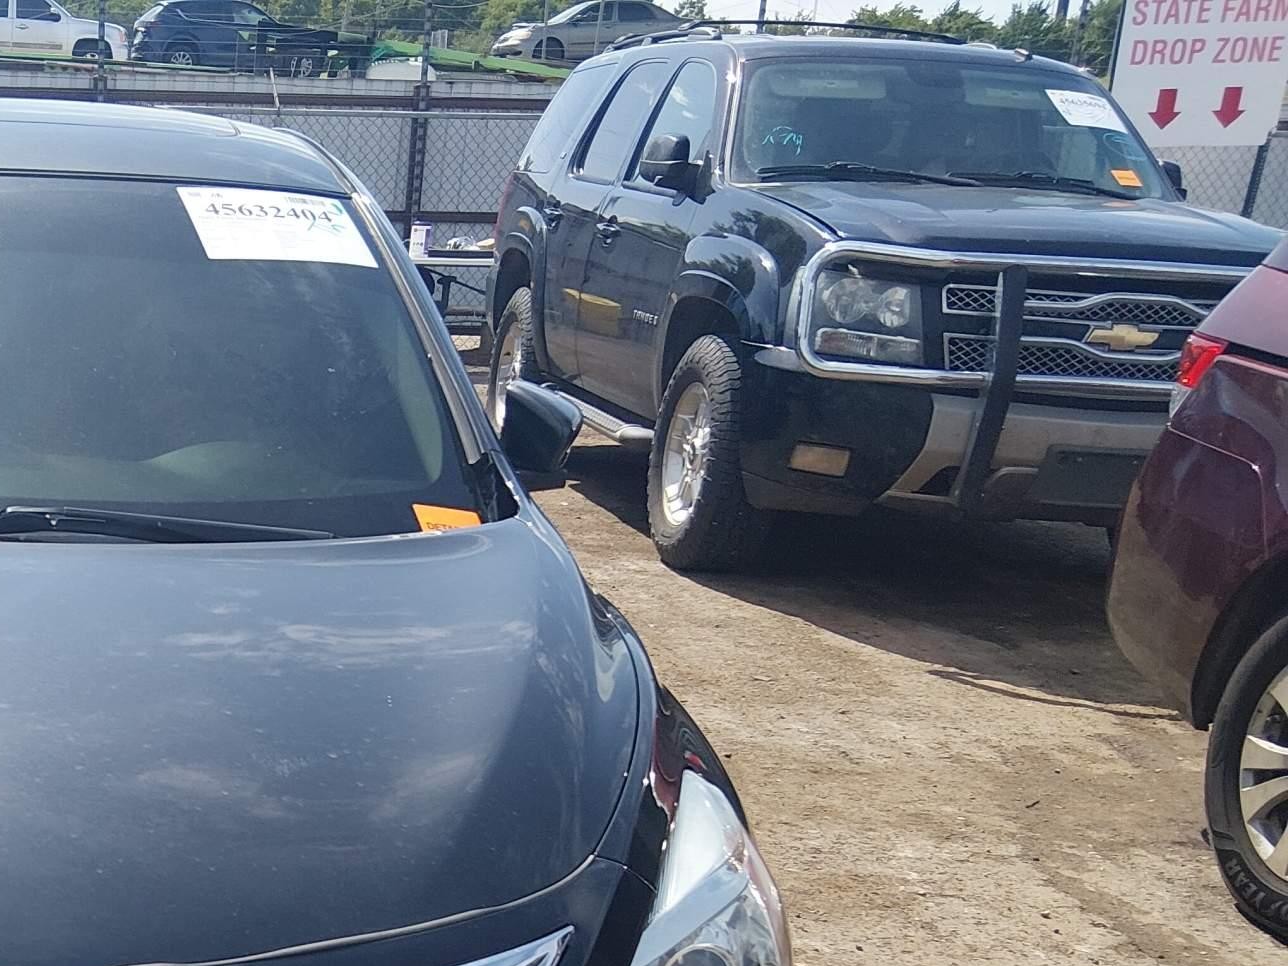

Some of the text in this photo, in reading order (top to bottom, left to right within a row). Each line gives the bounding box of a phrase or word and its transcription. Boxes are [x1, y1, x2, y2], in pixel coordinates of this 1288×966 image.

[1132, 0, 1288, 26] STATE FARM
[1129, 36, 1285, 66] DROP ZONE
[205, 202, 333, 223] 45632404
